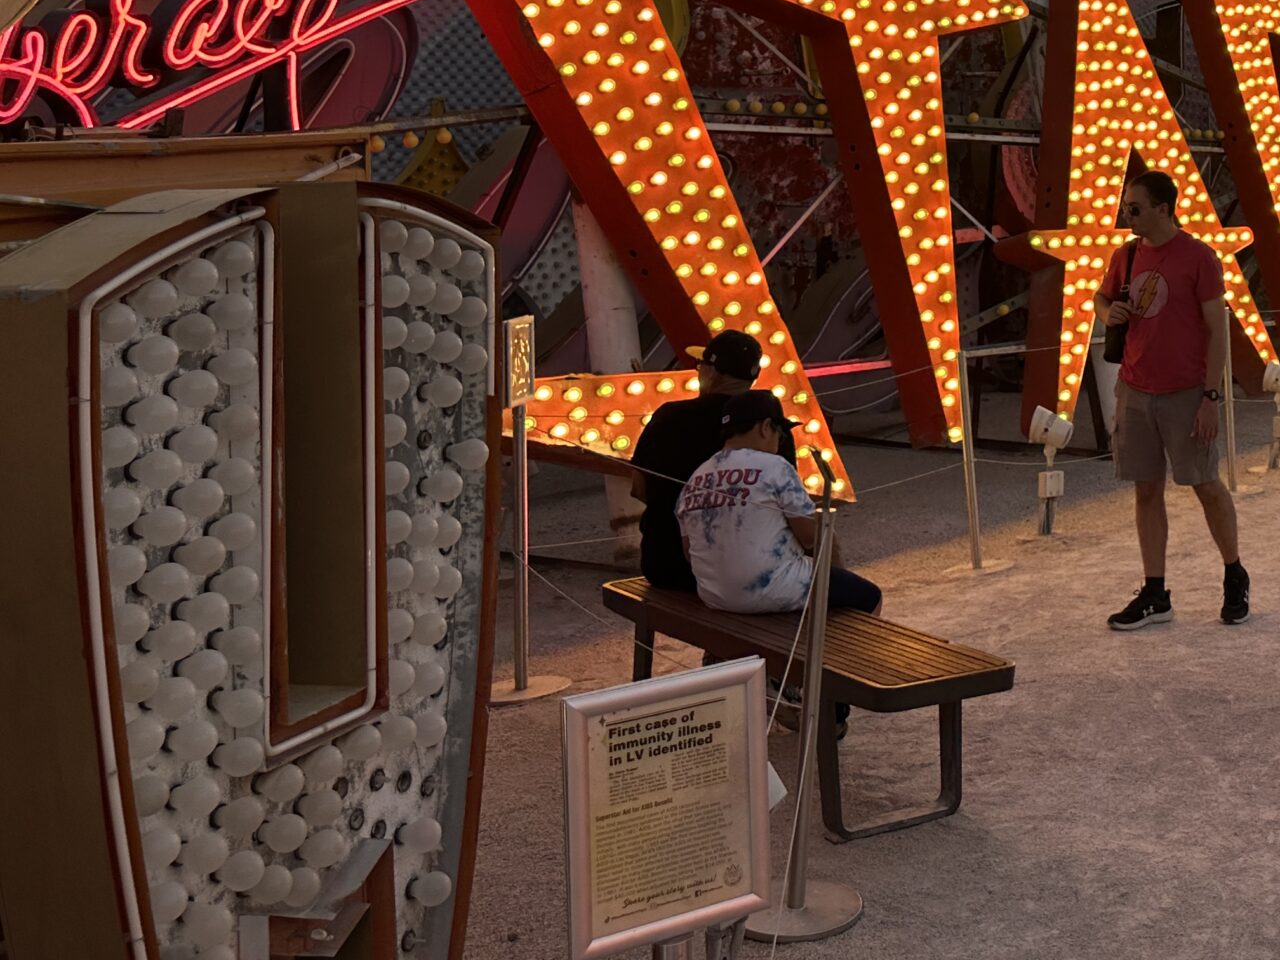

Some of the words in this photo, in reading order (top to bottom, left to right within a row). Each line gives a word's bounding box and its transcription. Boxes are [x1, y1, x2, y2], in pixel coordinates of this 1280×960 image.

[716, 469, 762, 487] YOU
[608, 723, 642, 739] First
[645, 716, 678, 731] case
[681, 711, 695, 723] of
[608, 731, 674, 753] immunity
[678, 720, 721, 738] illness
[609, 755, 623, 767] in
[627, 749, 645, 763] LV
[648, 733, 713, 758] identified
